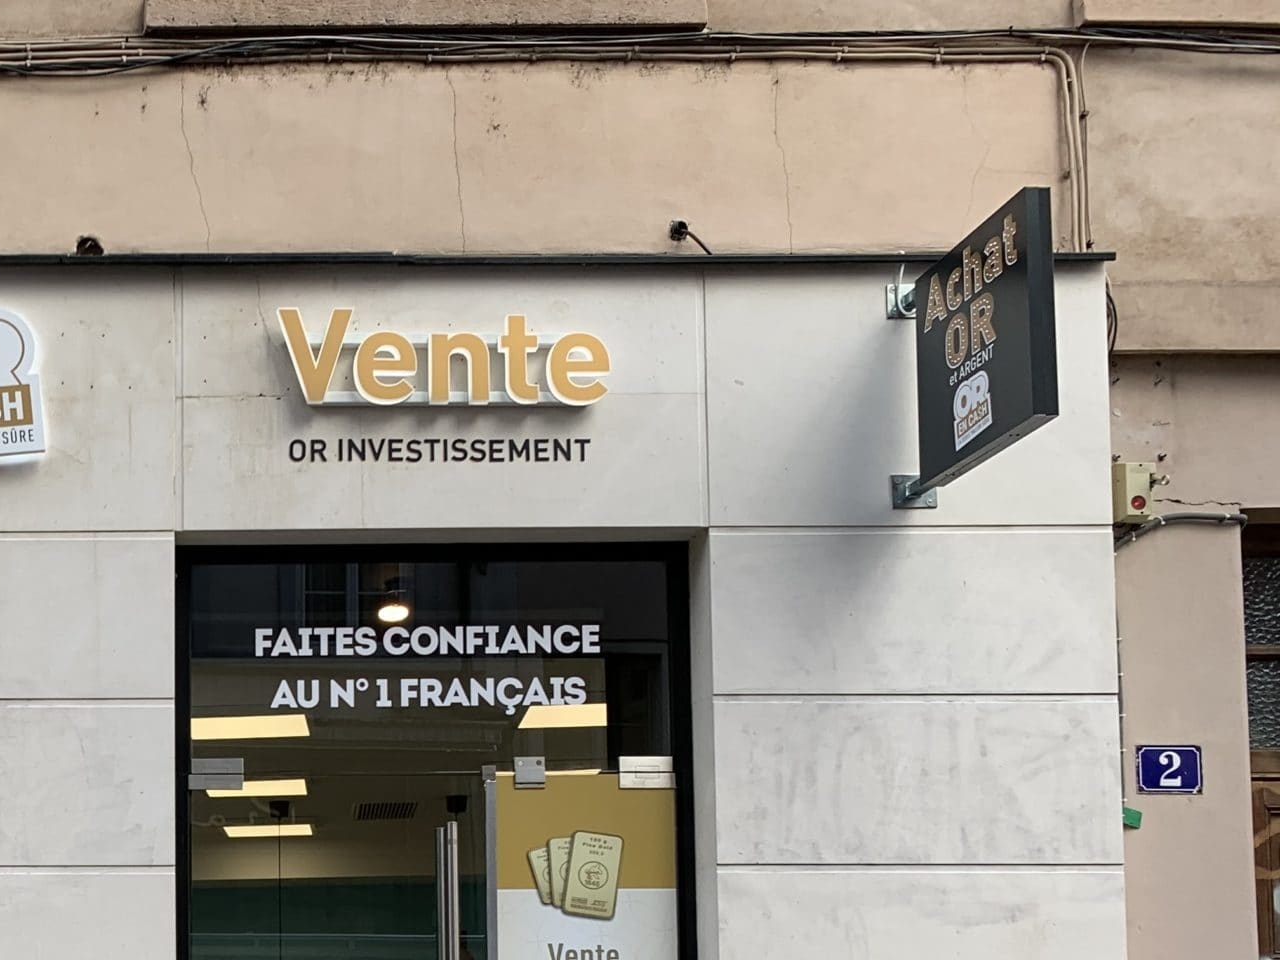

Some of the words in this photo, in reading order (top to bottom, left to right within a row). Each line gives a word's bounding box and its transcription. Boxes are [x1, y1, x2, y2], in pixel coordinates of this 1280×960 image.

[924, 213, 1018, 334] Achat
[944, 291, 997, 370] OR
[276, 307, 612, 406] Vente
[949, 371, 958, 387] et
[959, 343, 995, 381] ARGENT
[955, 373, 990, 420] OR
[1, 428, 35, 444] SÛRE
[289, 439, 327, 463] OR
[337, 438, 592, 463] INVESTISSEMENT
[255, 627, 377, 658] FAITES
[382, 625, 601, 656] CONFIANCE
[271, 681, 320, 709] AU
[330, 680, 369, 708] N°
[375, 680, 392, 708] 1
[401, 676, 587, 716] FRANÇAIS
[1158, 751, 1182, 787] 2
